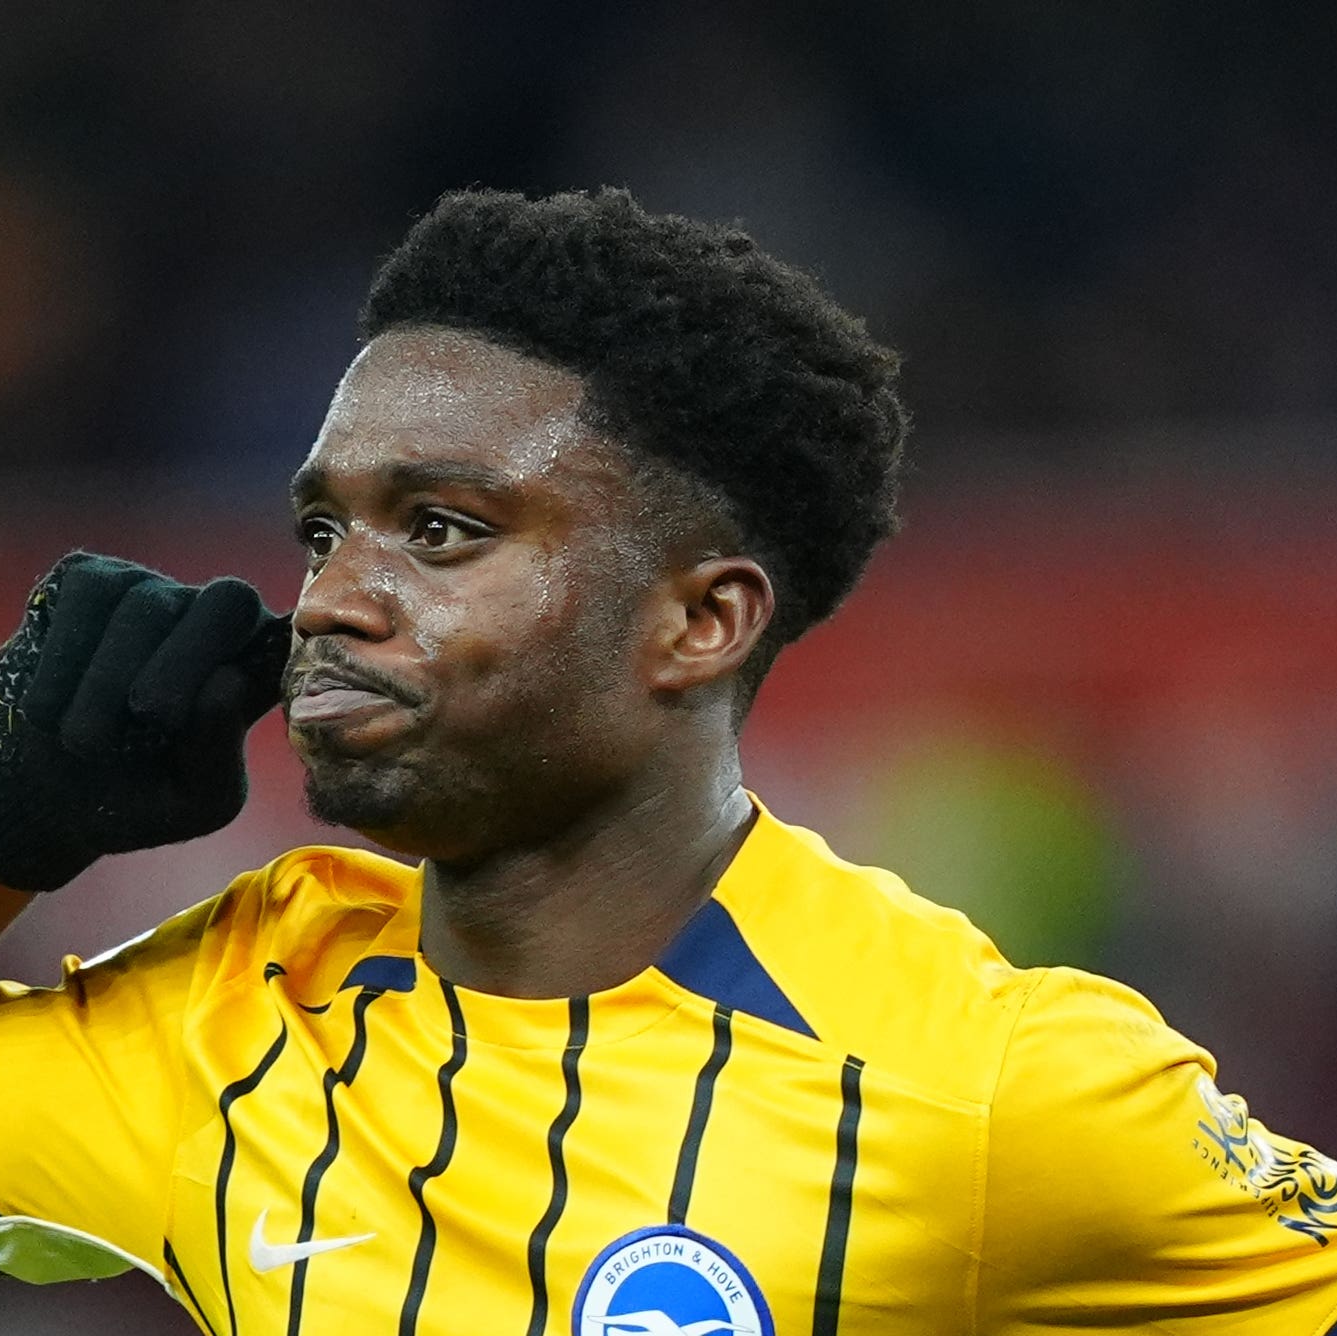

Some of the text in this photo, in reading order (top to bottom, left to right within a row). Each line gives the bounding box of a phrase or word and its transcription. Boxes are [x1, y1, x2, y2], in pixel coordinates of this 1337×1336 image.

[605, 1242, 743, 1304] BRIGHTON & HOVE
